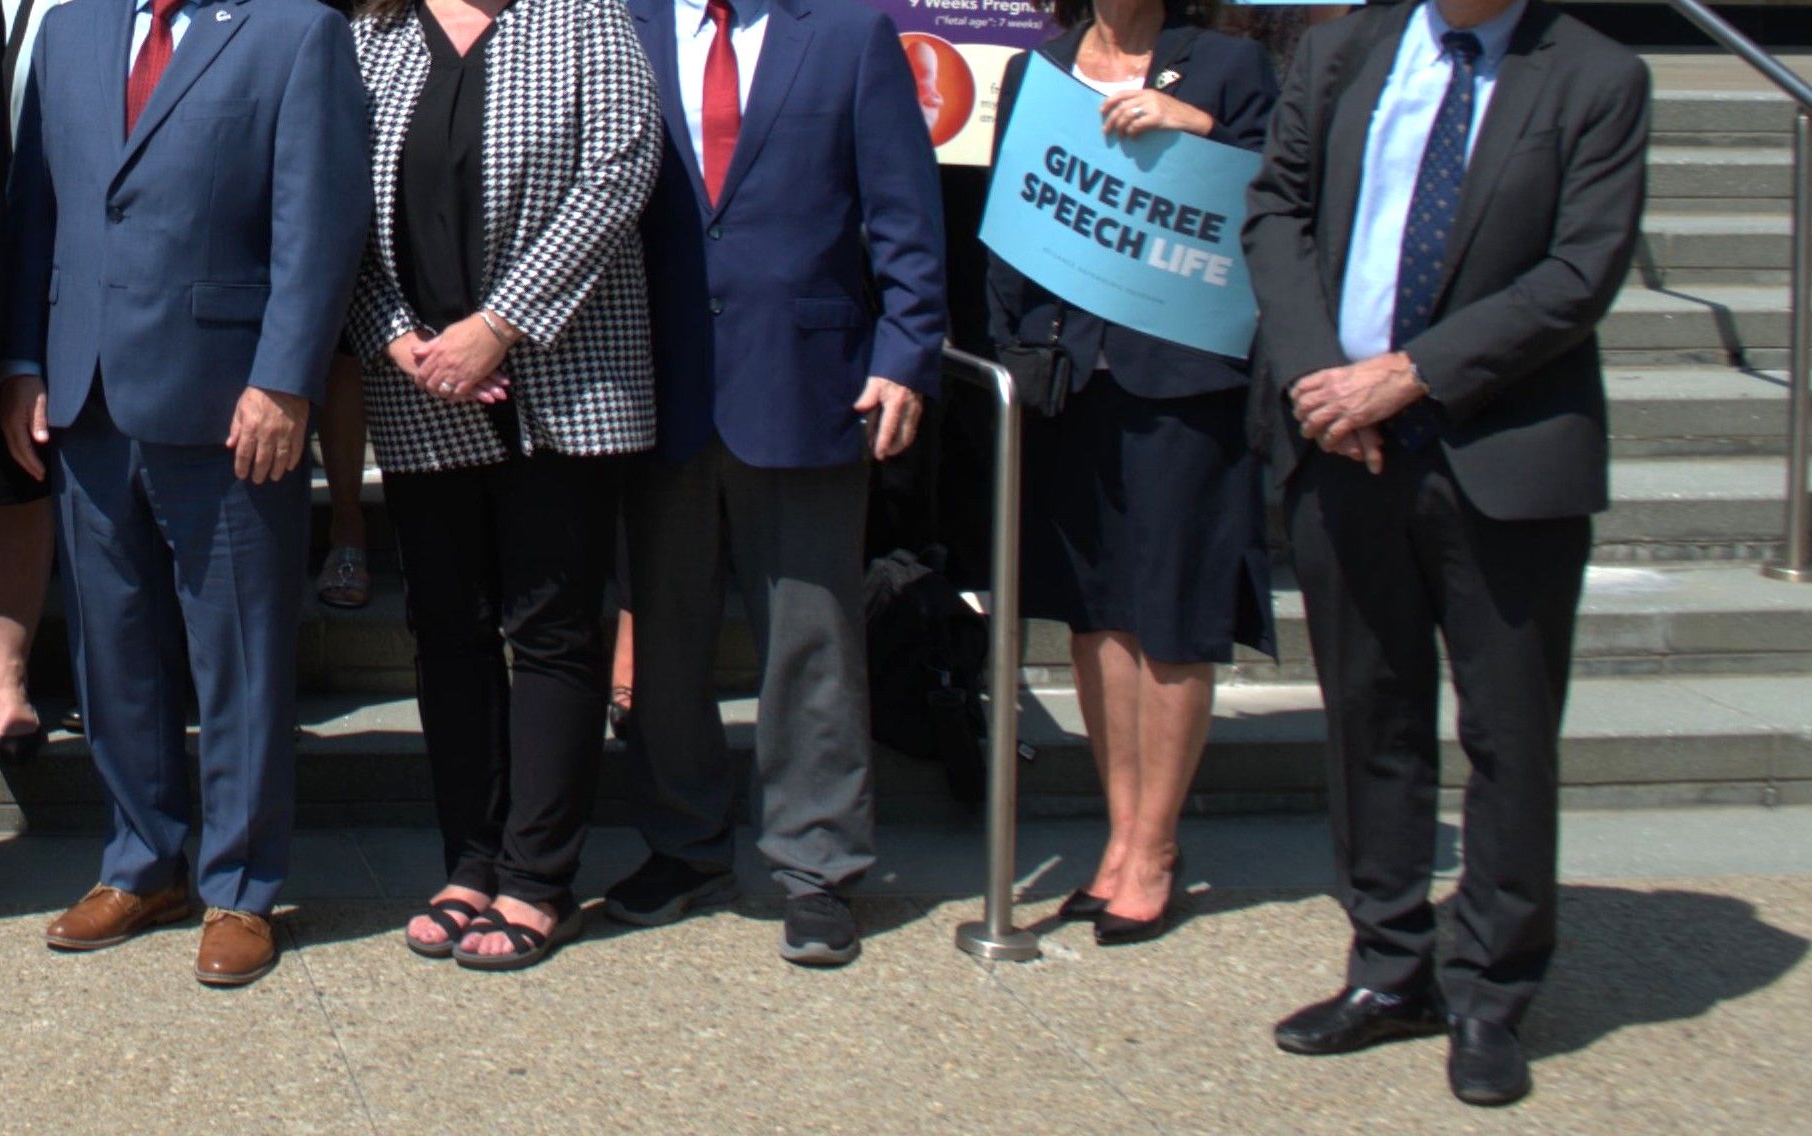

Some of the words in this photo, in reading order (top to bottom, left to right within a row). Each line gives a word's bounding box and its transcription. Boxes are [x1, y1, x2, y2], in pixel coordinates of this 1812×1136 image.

[999, 18, 1005, 26] 7
[1007, 19, 1043, 29] weeks)
[1021, 172, 1147, 260] SPEECH
[1147, 238, 1233, 287] LIFE
[1044, 145, 1125, 209] GIVE
[1126, 186, 1227, 244] FREE
